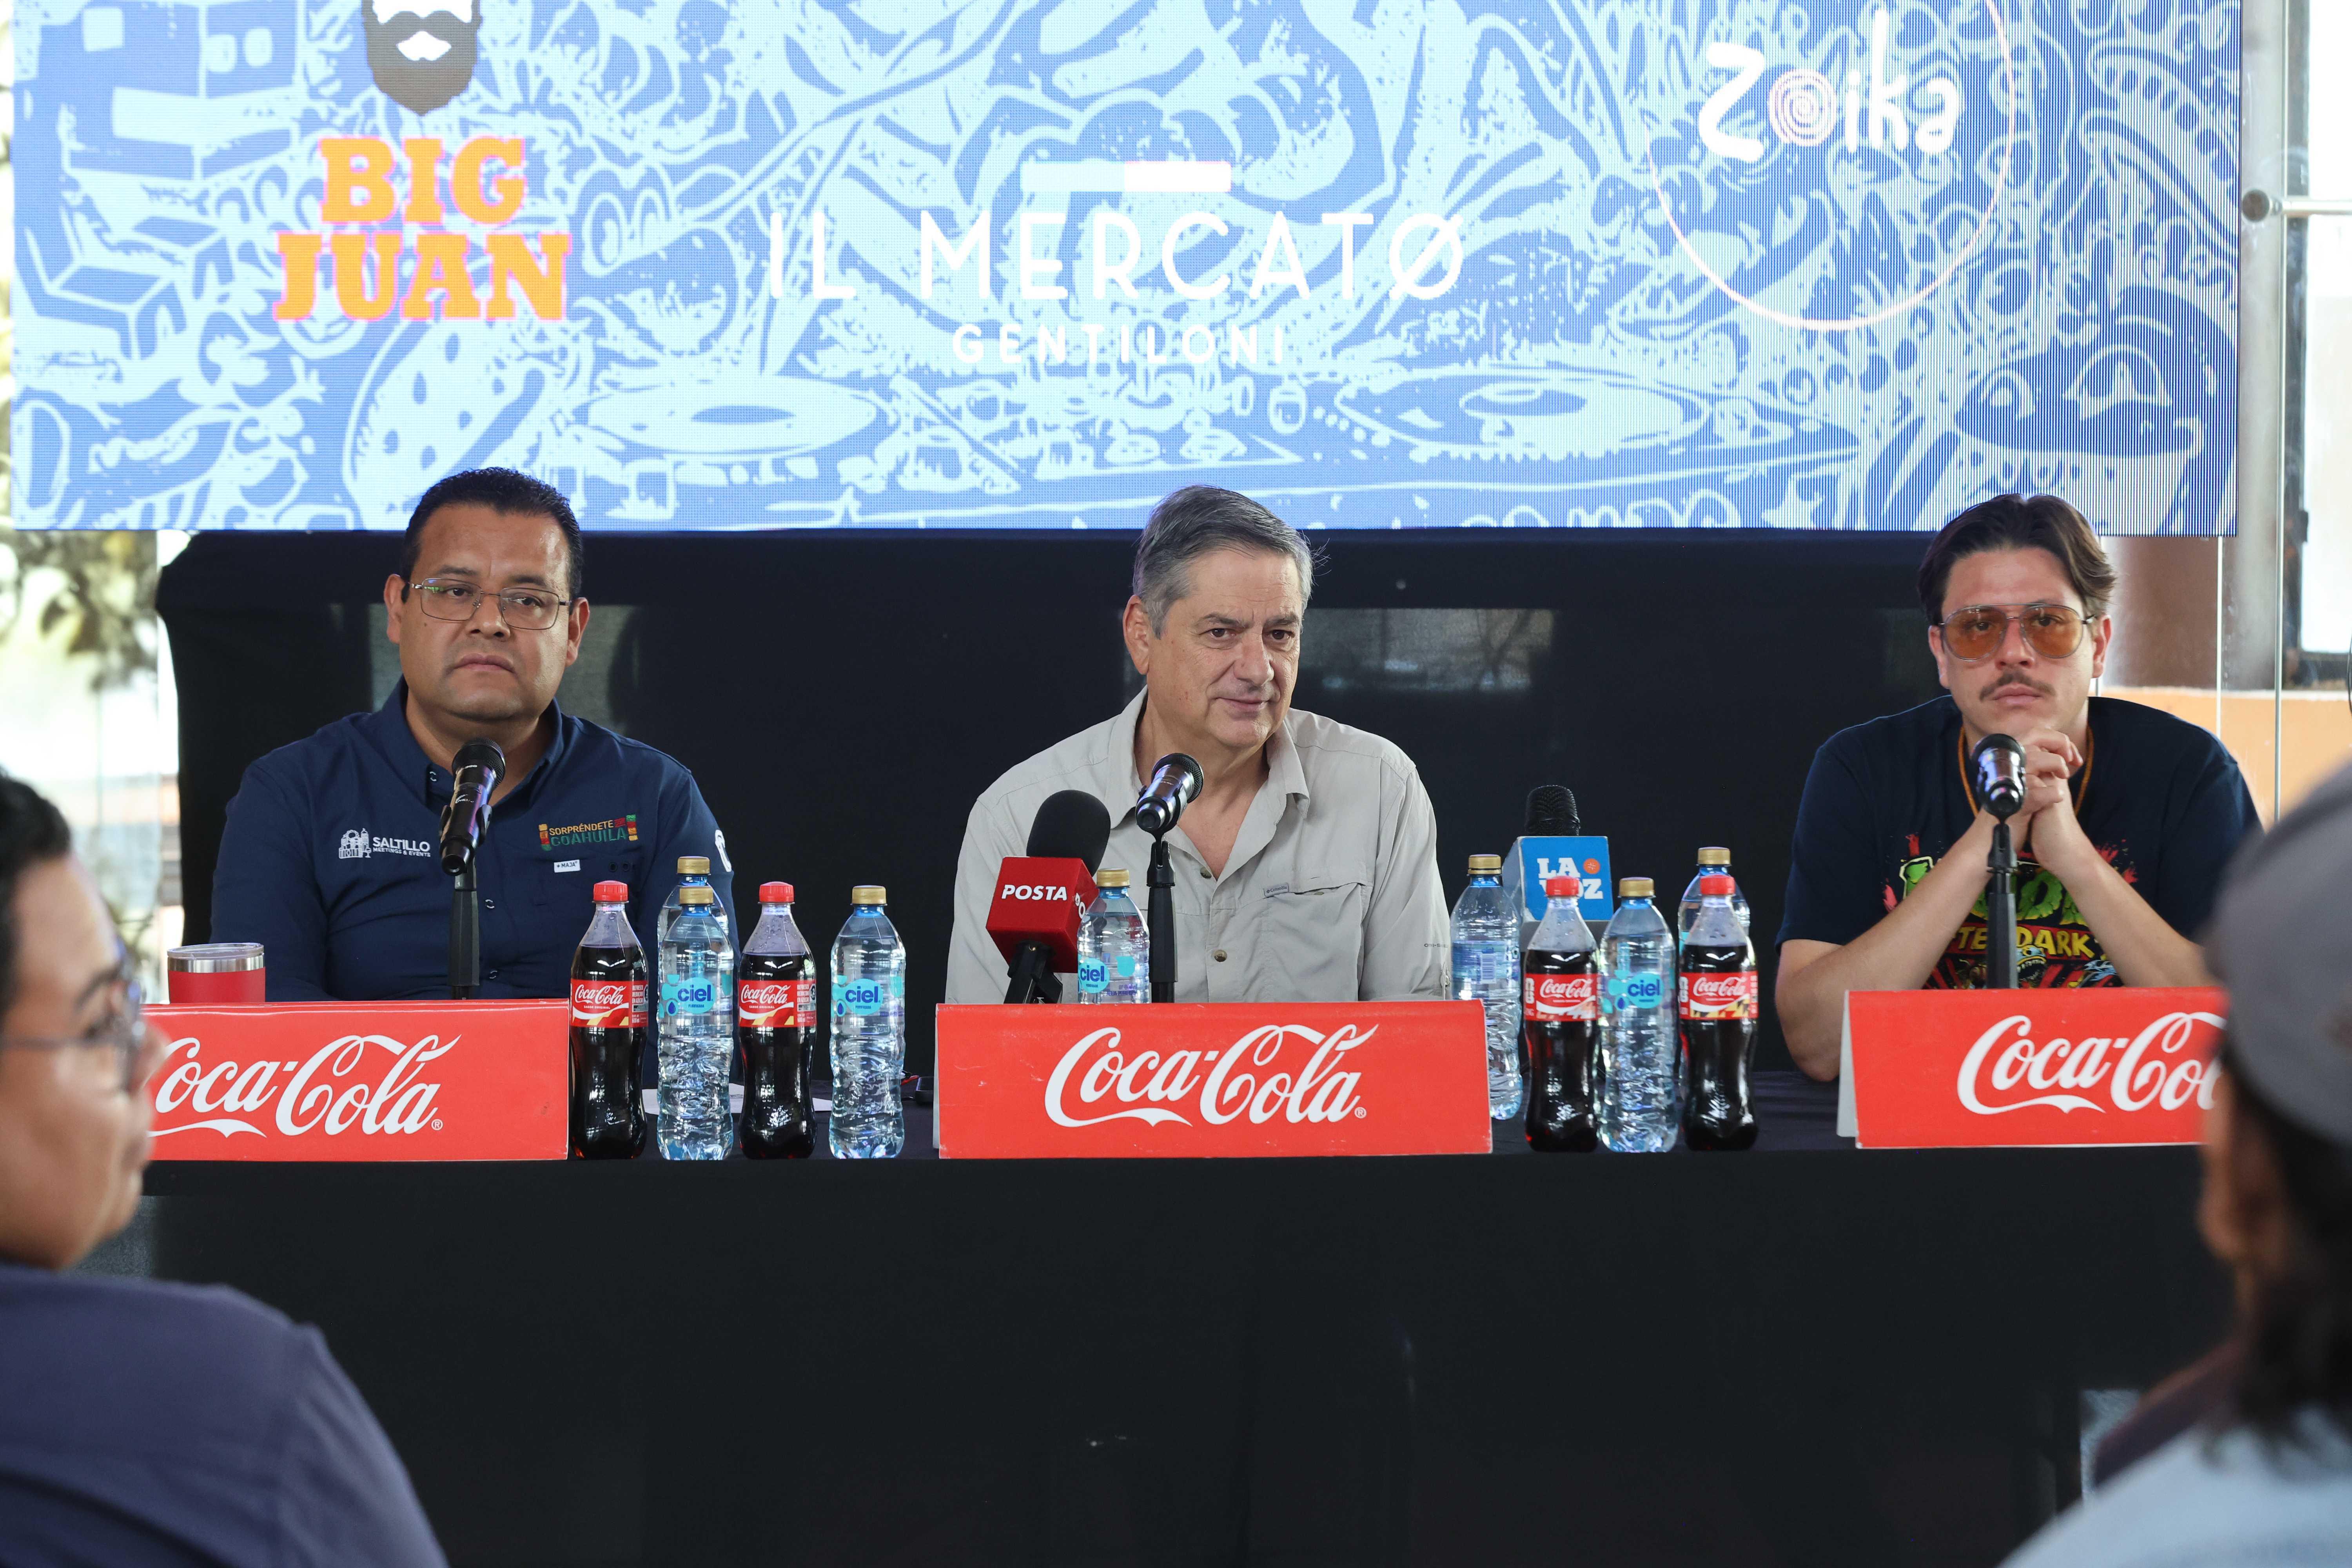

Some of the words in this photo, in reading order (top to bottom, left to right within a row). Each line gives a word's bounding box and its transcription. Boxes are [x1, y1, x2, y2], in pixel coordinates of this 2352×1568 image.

[318, 136, 526, 224] BIG
[769, 210, 857, 299] IL
[272, 232, 573, 320] JUAN
[952, 322, 1284, 365] GENTILONI
[549, 820, 614, 836] SORPRÉNDETE
[551, 827, 628, 846] COAHUILA
[372, 837, 430, 852] SALTILLO
[1537, 857, 1581, 878] LA
[1001, 884, 1067, 901] POSTA
[2016, 926, 2095, 958] DARK
[1080, 965, 1105, 982] ciel
[575, 984, 627, 1005] Coca-Cola
[677, 984, 711, 1002] ciel
[741, 984, 791, 1004] Coca-Cola
[845, 986, 878, 1003] ciel
[1540, 978, 1594, 998] Coca-Cola
[1628, 979, 1661, 997] ciel
[1693, 976, 1747, 996] Coca-Cola
[1044, 1023, 1379, 1128] Coca-Cola
